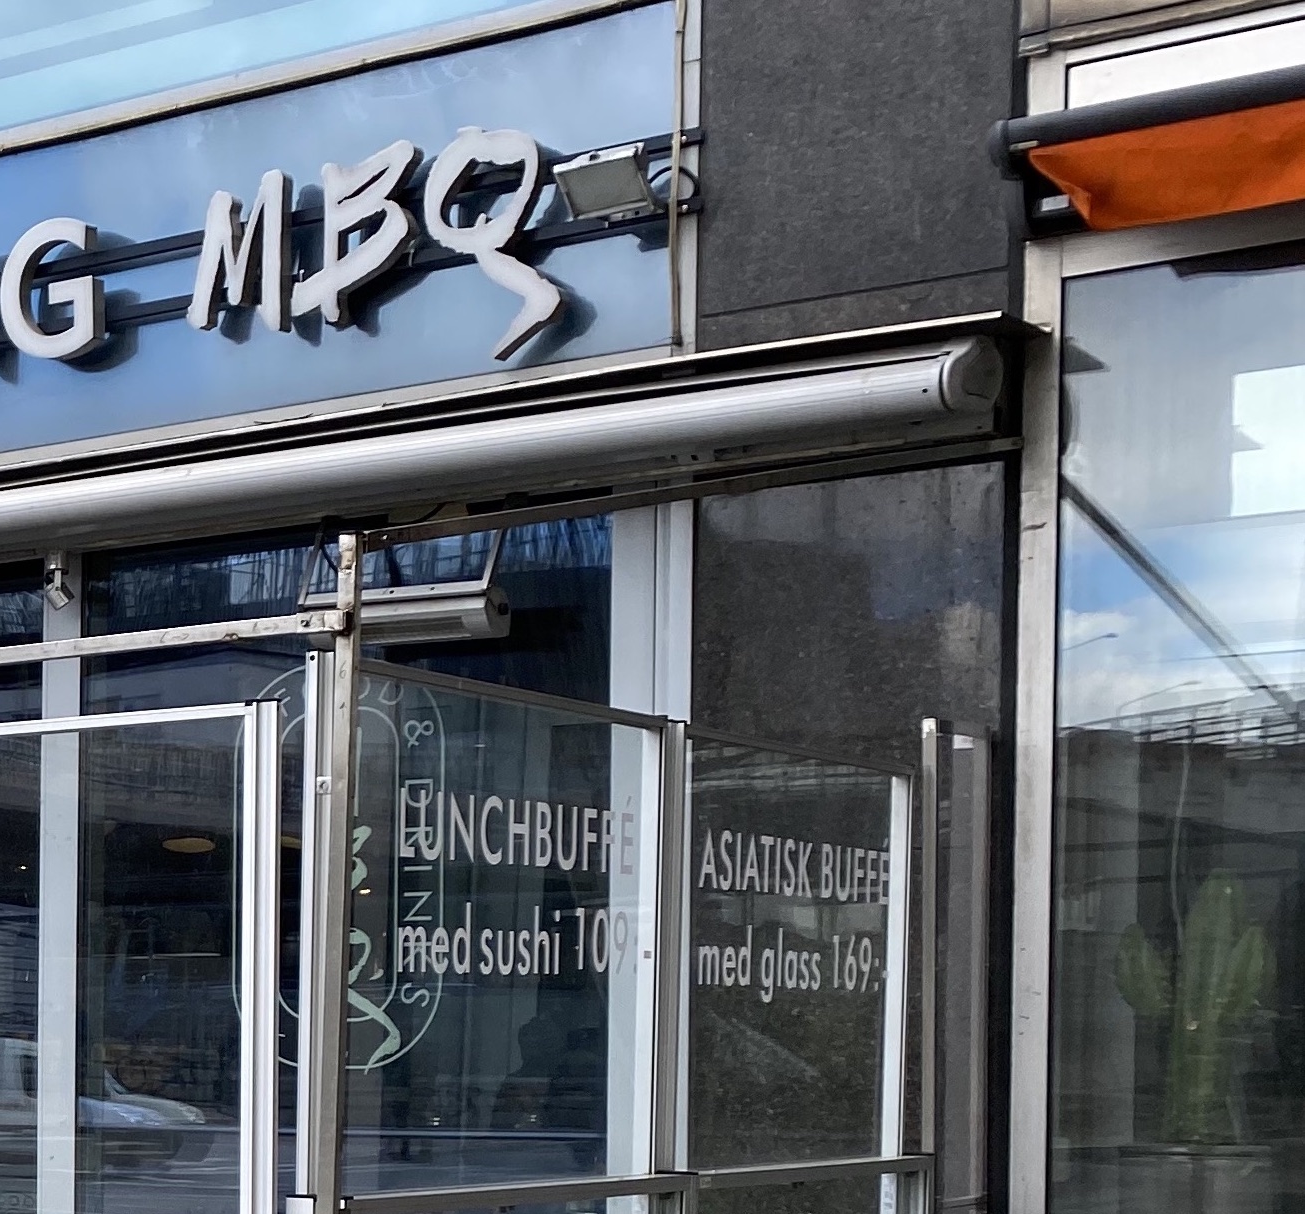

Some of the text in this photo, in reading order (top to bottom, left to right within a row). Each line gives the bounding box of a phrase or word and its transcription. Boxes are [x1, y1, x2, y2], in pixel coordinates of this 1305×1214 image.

[187, 126, 563, 361] MBQ
[399, 787, 636, 876] LUNCHBUFFÉ
[698, 828, 890, 905] ASIATISK BUFFÉ
[397, 901, 471, 975] med
[479, 905, 560, 977] sushi
[697, 924, 752, 987] med
[760, 926, 821, 1003] glass
